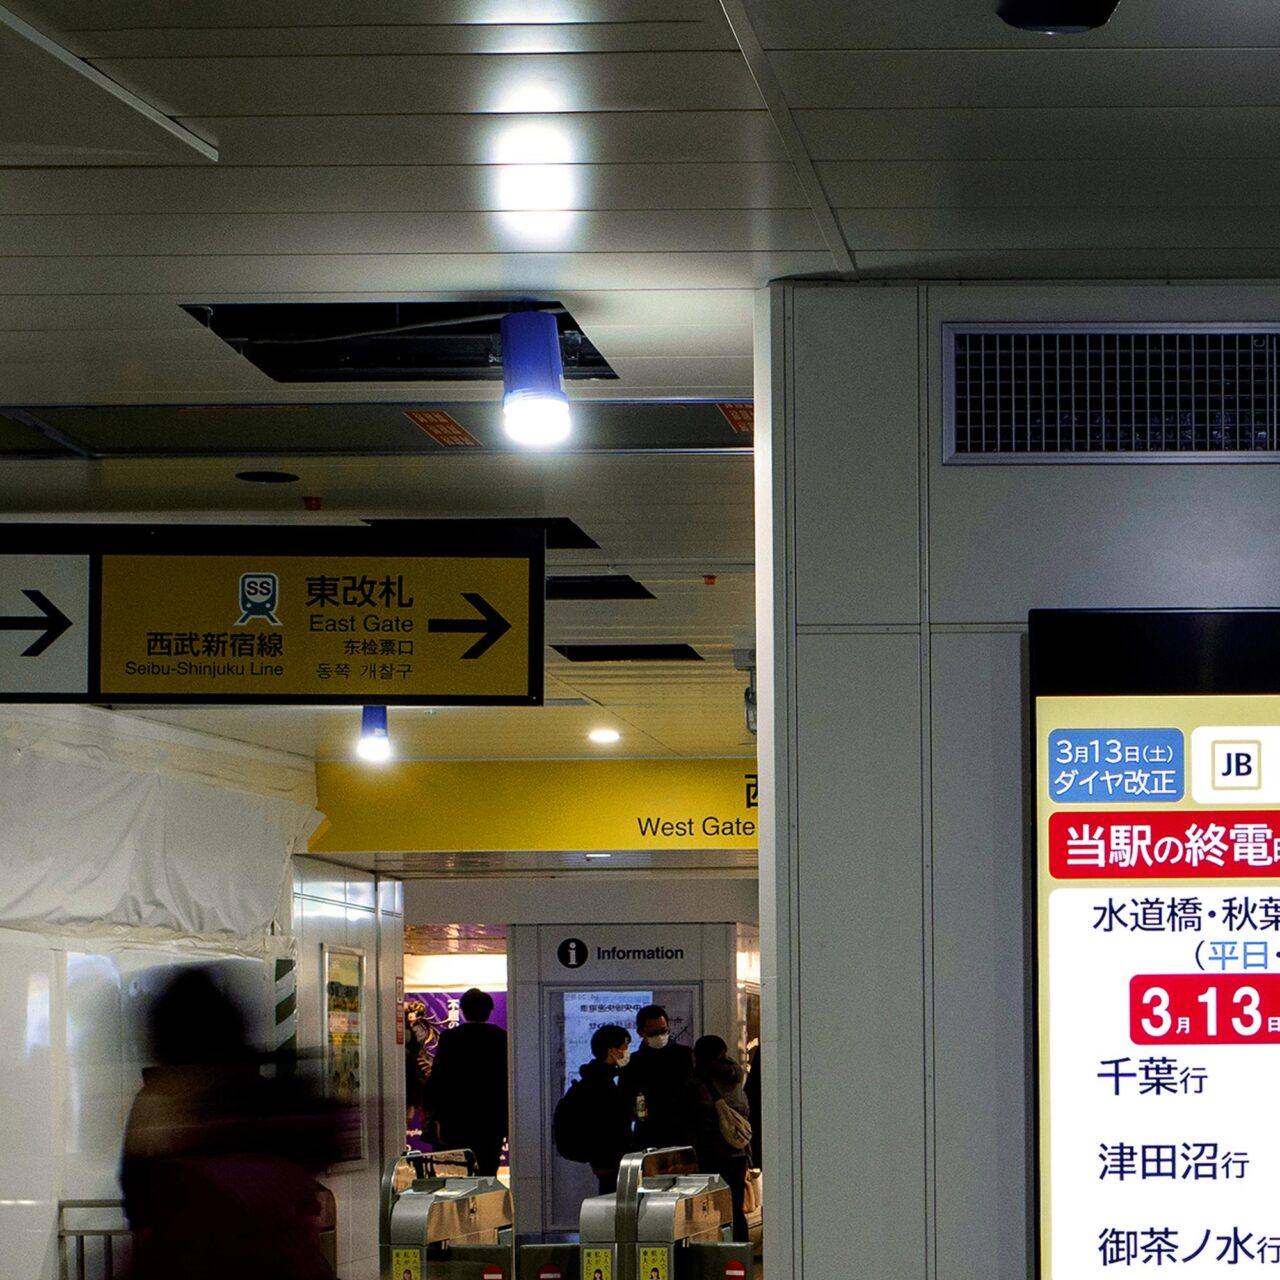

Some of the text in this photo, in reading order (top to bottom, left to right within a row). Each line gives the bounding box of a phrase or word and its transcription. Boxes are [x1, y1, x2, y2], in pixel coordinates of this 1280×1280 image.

[246, 581, 271, 596] SS
[306, 576, 414, 608] 東改札
[310, 615, 414, 633] East Gate
[146, 631, 284, 658] 西武新宿線
[343, 638, 414, 656] 东检票口
[126, 661, 283, 678] Seibu-Shinjuku Line
[316, 663, 412, 680] 동쪽 개찰구
[1221, 752, 1252, 777] JB
[1055, 770, 1176, 794] ダイヤ改正
[638, 817, 755, 836] West Gate
[597, 947, 684, 960] Information
[1097, 1057, 1208, 1095] 千葉行
[1099, 1143, 1249, 1180] 津田沼行
